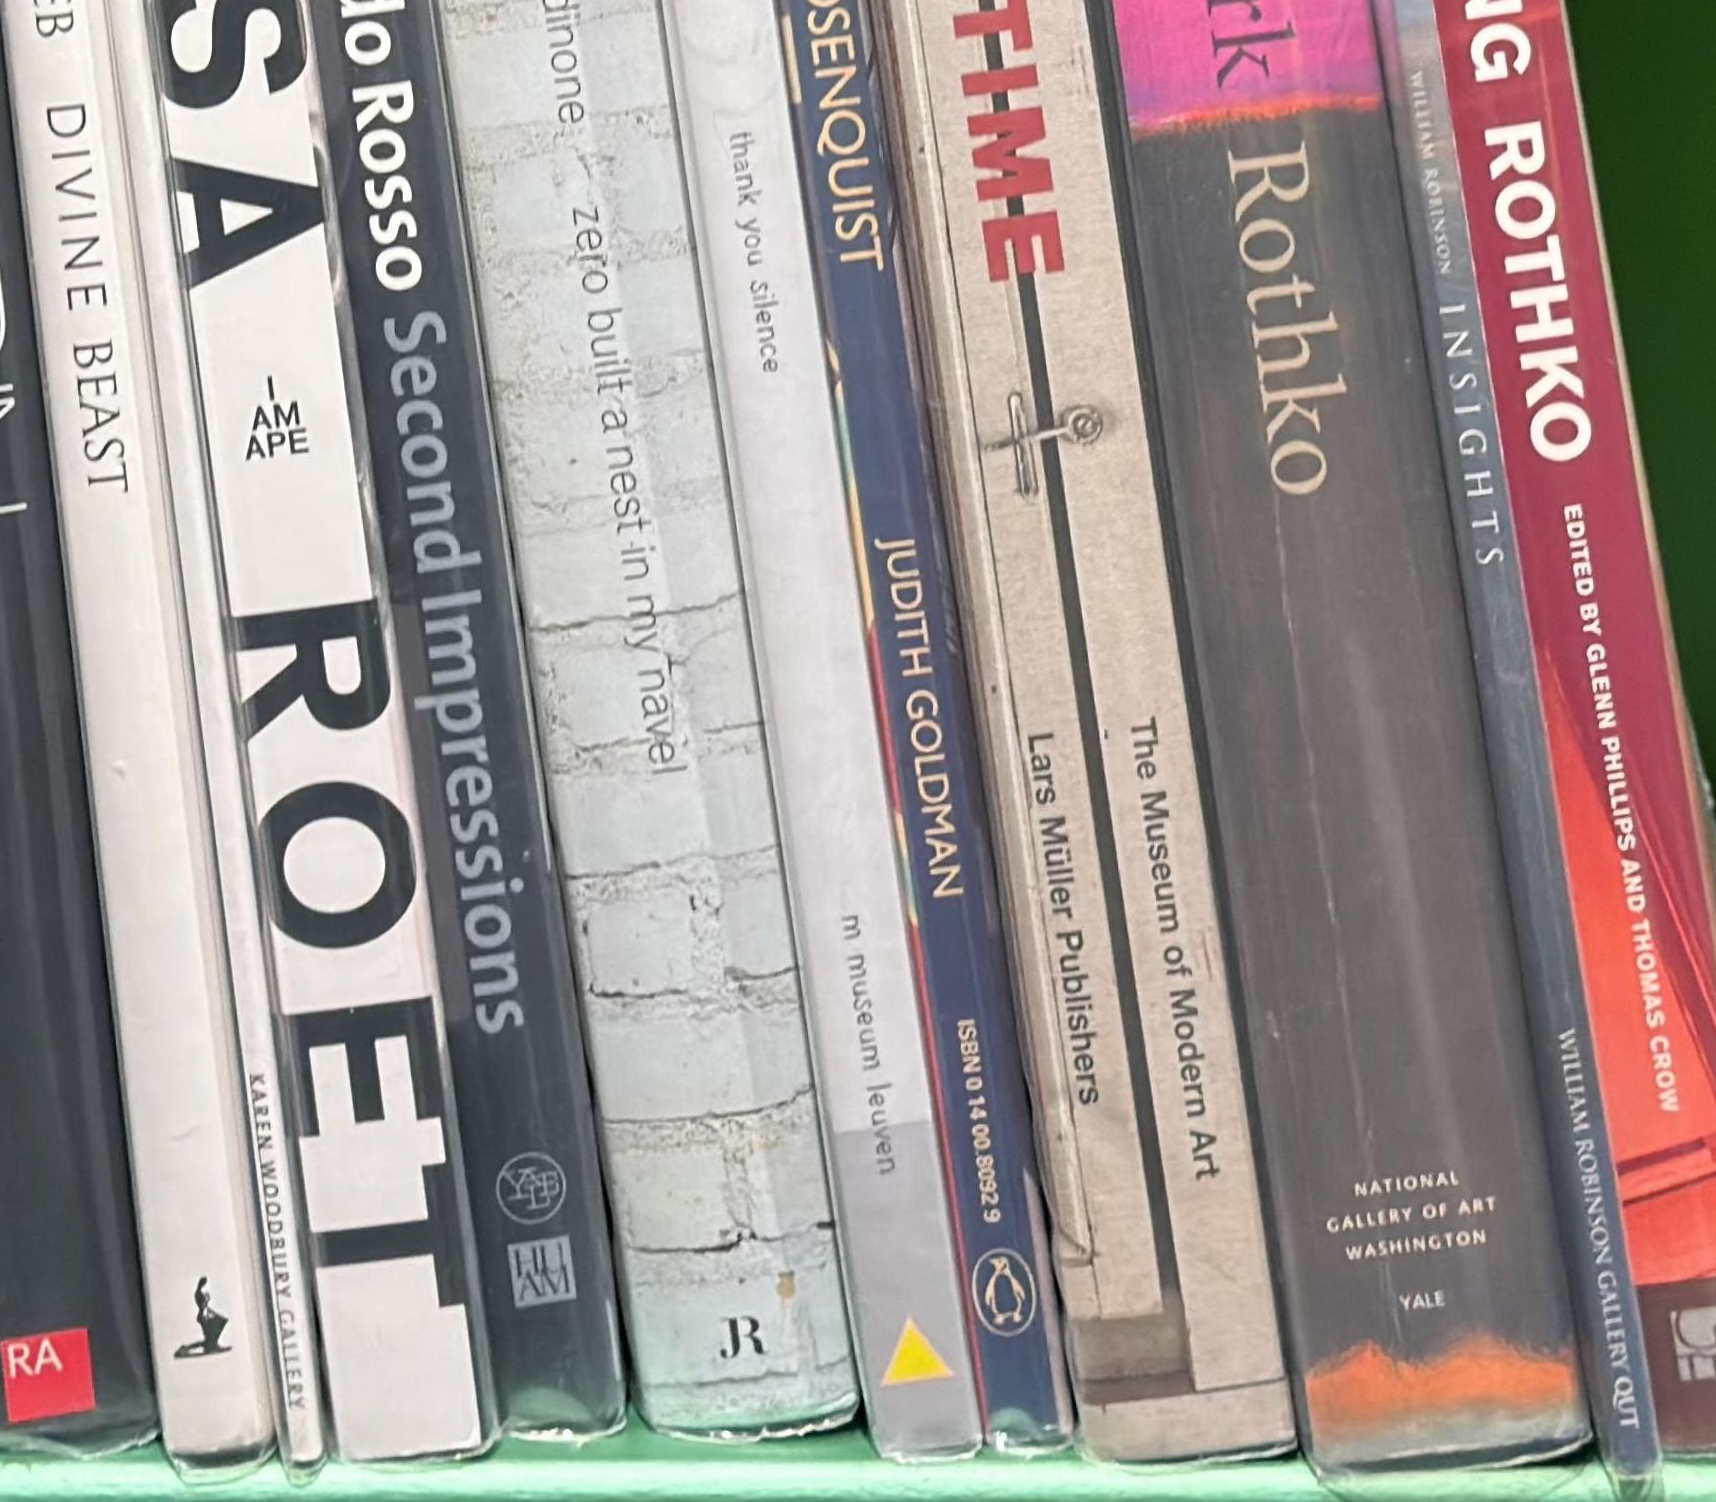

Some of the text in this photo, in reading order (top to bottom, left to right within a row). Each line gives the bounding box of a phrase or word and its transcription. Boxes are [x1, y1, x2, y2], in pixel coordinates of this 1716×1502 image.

[45, 103, 108, 312] DIVINE
[351, 79, 424, 292] Rosso
[1409, 69, 1452, 276] WILLIAM ROBINSON
[572, 205, 610, 295] zero
[729, 129, 780, 374] thank you silence
[1483, 118, 1593, 463] ROTHKO
[586, 306, 634, 395] built
[1227, 139, 1349, 497] Rothko
[72, 338, 130, 495] BEAST
[251, 400, 302, 432] AM
[265, 375, 276, 401] I
[600, 409, 629, 435] a
[1437, 301, 1505, 566] INSIGHTS
[245, 428, 311, 463] APE
[384, 310, 483, 575] Second
[606, 444, 652, 538] nest
[620, 545, 657, 582] in
[623, 596, 661, 654] my
[637, 669, 689, 776] navel
[874, 537, 966, 900] JUDITH GOLDMAN
[413, 588, 526, 1036] Impressions
[1563, 503, 1680, 1113] EDITED BY GLENN PHILLIPS AND THOMAS CROW
[228, 598, 467, 1309] ROET
[1027, 731, 1100, 1107] Lars Müller Publishers
[1130, 715, 1222, 1183] The Museum of Modern Art
[839, 913, 897, 1177] m museum leuven
[957, 1018, 983, 1075] ISBN
[965, 1075, 984, 1092] 0
[968, 1095, 988, 1121] 14
[983, 1207, 1002, 1225] 9
[1325, 1195, 1497, 1235] GALLERY OF ART
[1353, 1169, 1461, 1199] NATIONAL
[1556, 1026, 1641, 1431] WILLIAM ROBINSON GALLERY QUT
[248, 1072, 306, 1412] KAREN WOODBURY GALLERY
[1345, 1228, 1488, 1263] WASHINGTON
[718, 1313, 769, 1359] JR
[1398, 1289, 1446, 1313] YALE
[6, 1337, 64, 1379] RA
